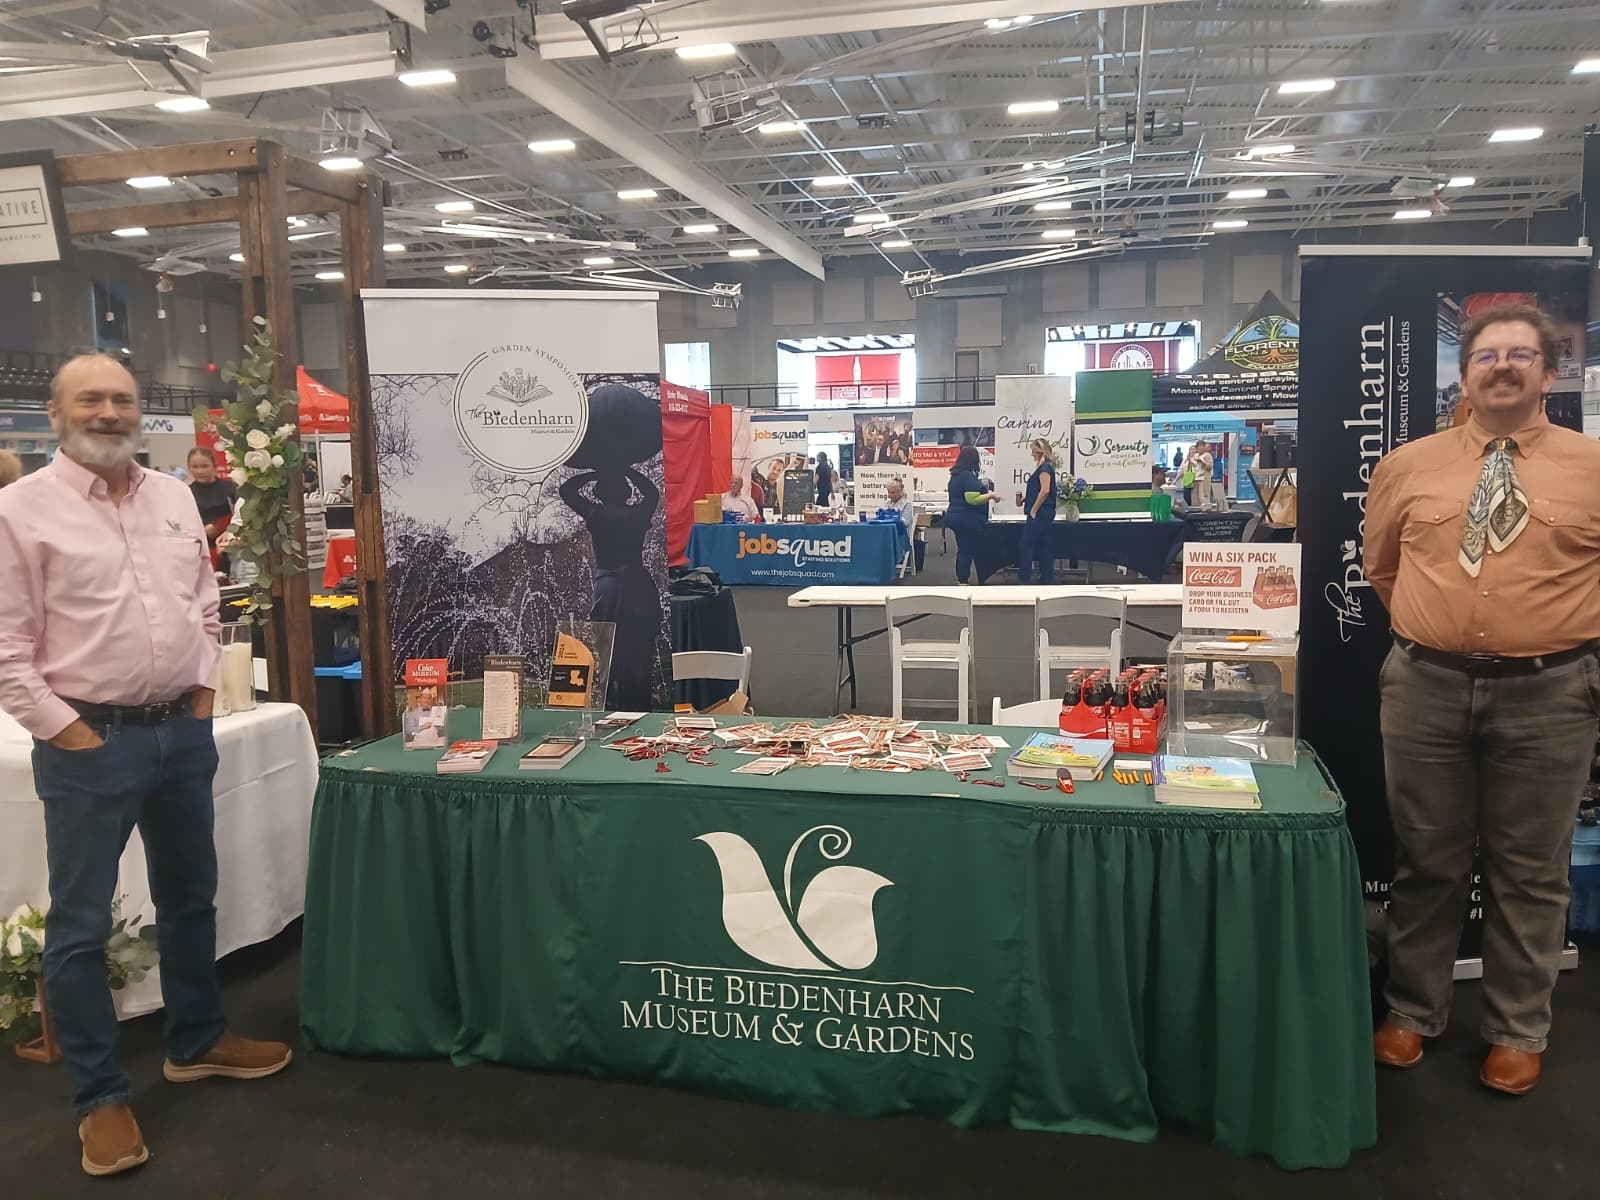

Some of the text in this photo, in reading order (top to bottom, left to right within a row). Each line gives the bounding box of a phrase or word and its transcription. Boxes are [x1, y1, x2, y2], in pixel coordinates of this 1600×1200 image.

[492, 344, 532, 354] GARDEN
[1397, 320, 1410, 377] Gardens
[1171, 387, 1218, 396] Mosquito
[1221, 385, 1259, 393] Control
[1398, 379, 1409, 392] &
[1201, 393, 1262, 401] Landscaping
[465, 403, 574, 426] The Biedenharn
[997, 415, 1052, 437] Caring
[752, 429, 806, 445] jobsquad
[1013, 432, 1069, 449] Hds
[1103, 438, 1149, 456] Serenity
[736, 531, 851, 567] jobsquad
[1189, 551, 1277, 563] WIN A SIX PACK
[751, 568, 834, 578] www.thejobsquad.com
[1325, 582, 1366, 642] The
[651, 968, 941, 1024] THE BIEDENHARN
[620, 1001, 975, 1061] MUSEUM & GARDENS
